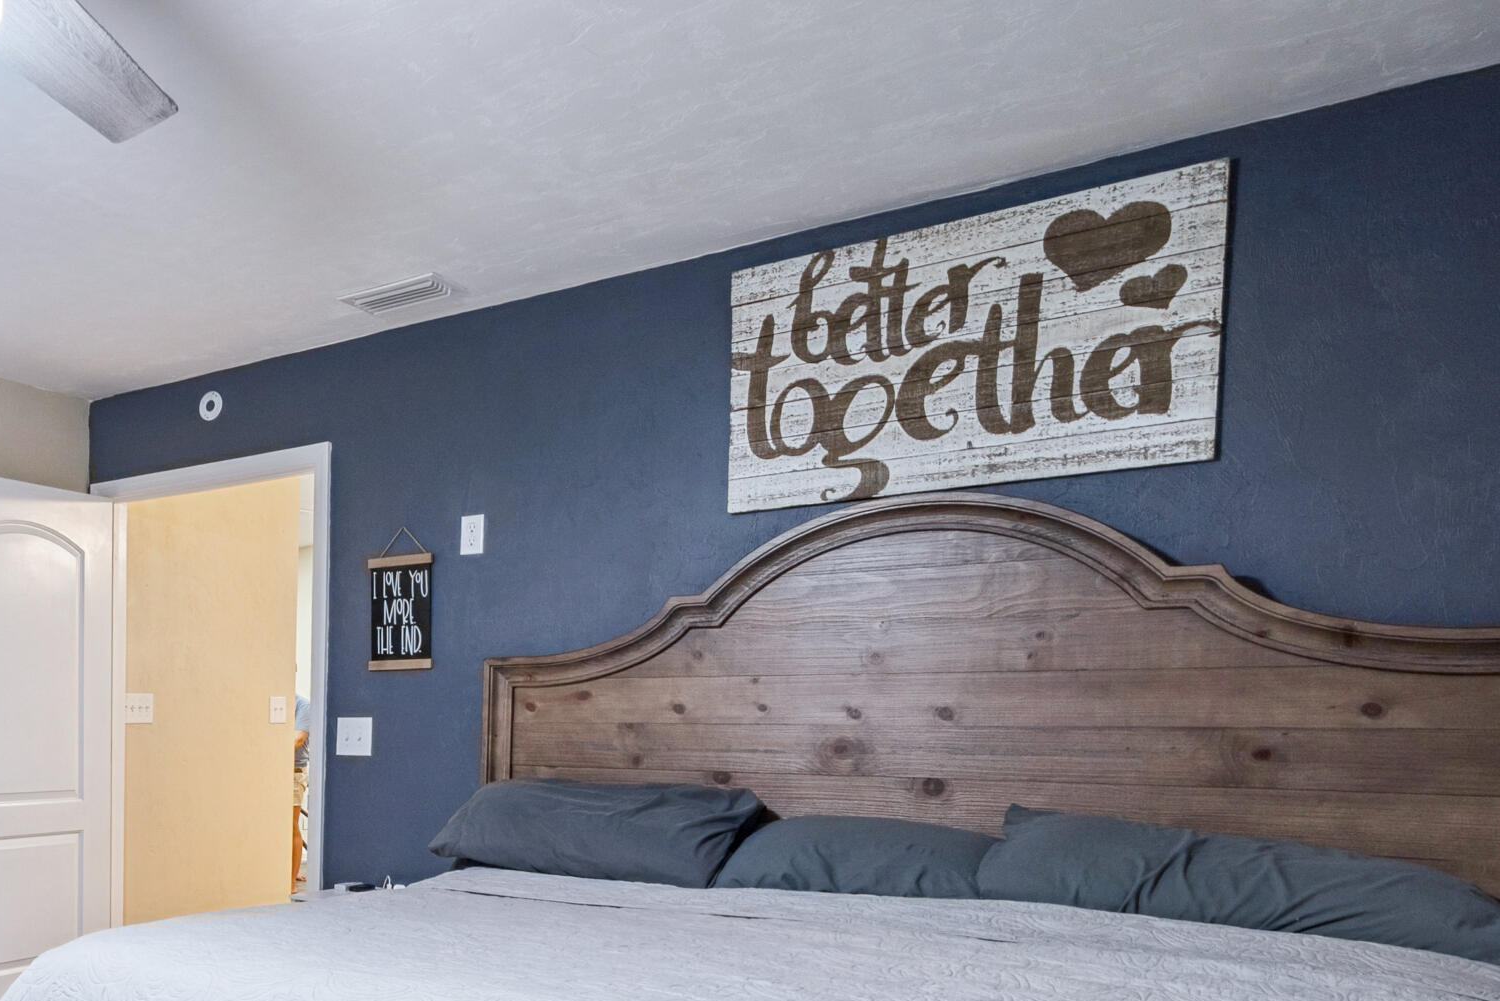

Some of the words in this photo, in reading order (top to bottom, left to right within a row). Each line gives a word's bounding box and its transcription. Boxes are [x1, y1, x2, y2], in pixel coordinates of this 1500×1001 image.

[786, 237, 1008, 366] better
[731, 272, 1221, 502] together
[372, 571, 377, 599] I
[383, 570, 402, 598] LOVE
[409, 569, 429, 599] YOU
[377, 625, 394, 655] THE
[401, 625, 422, 656] END.
